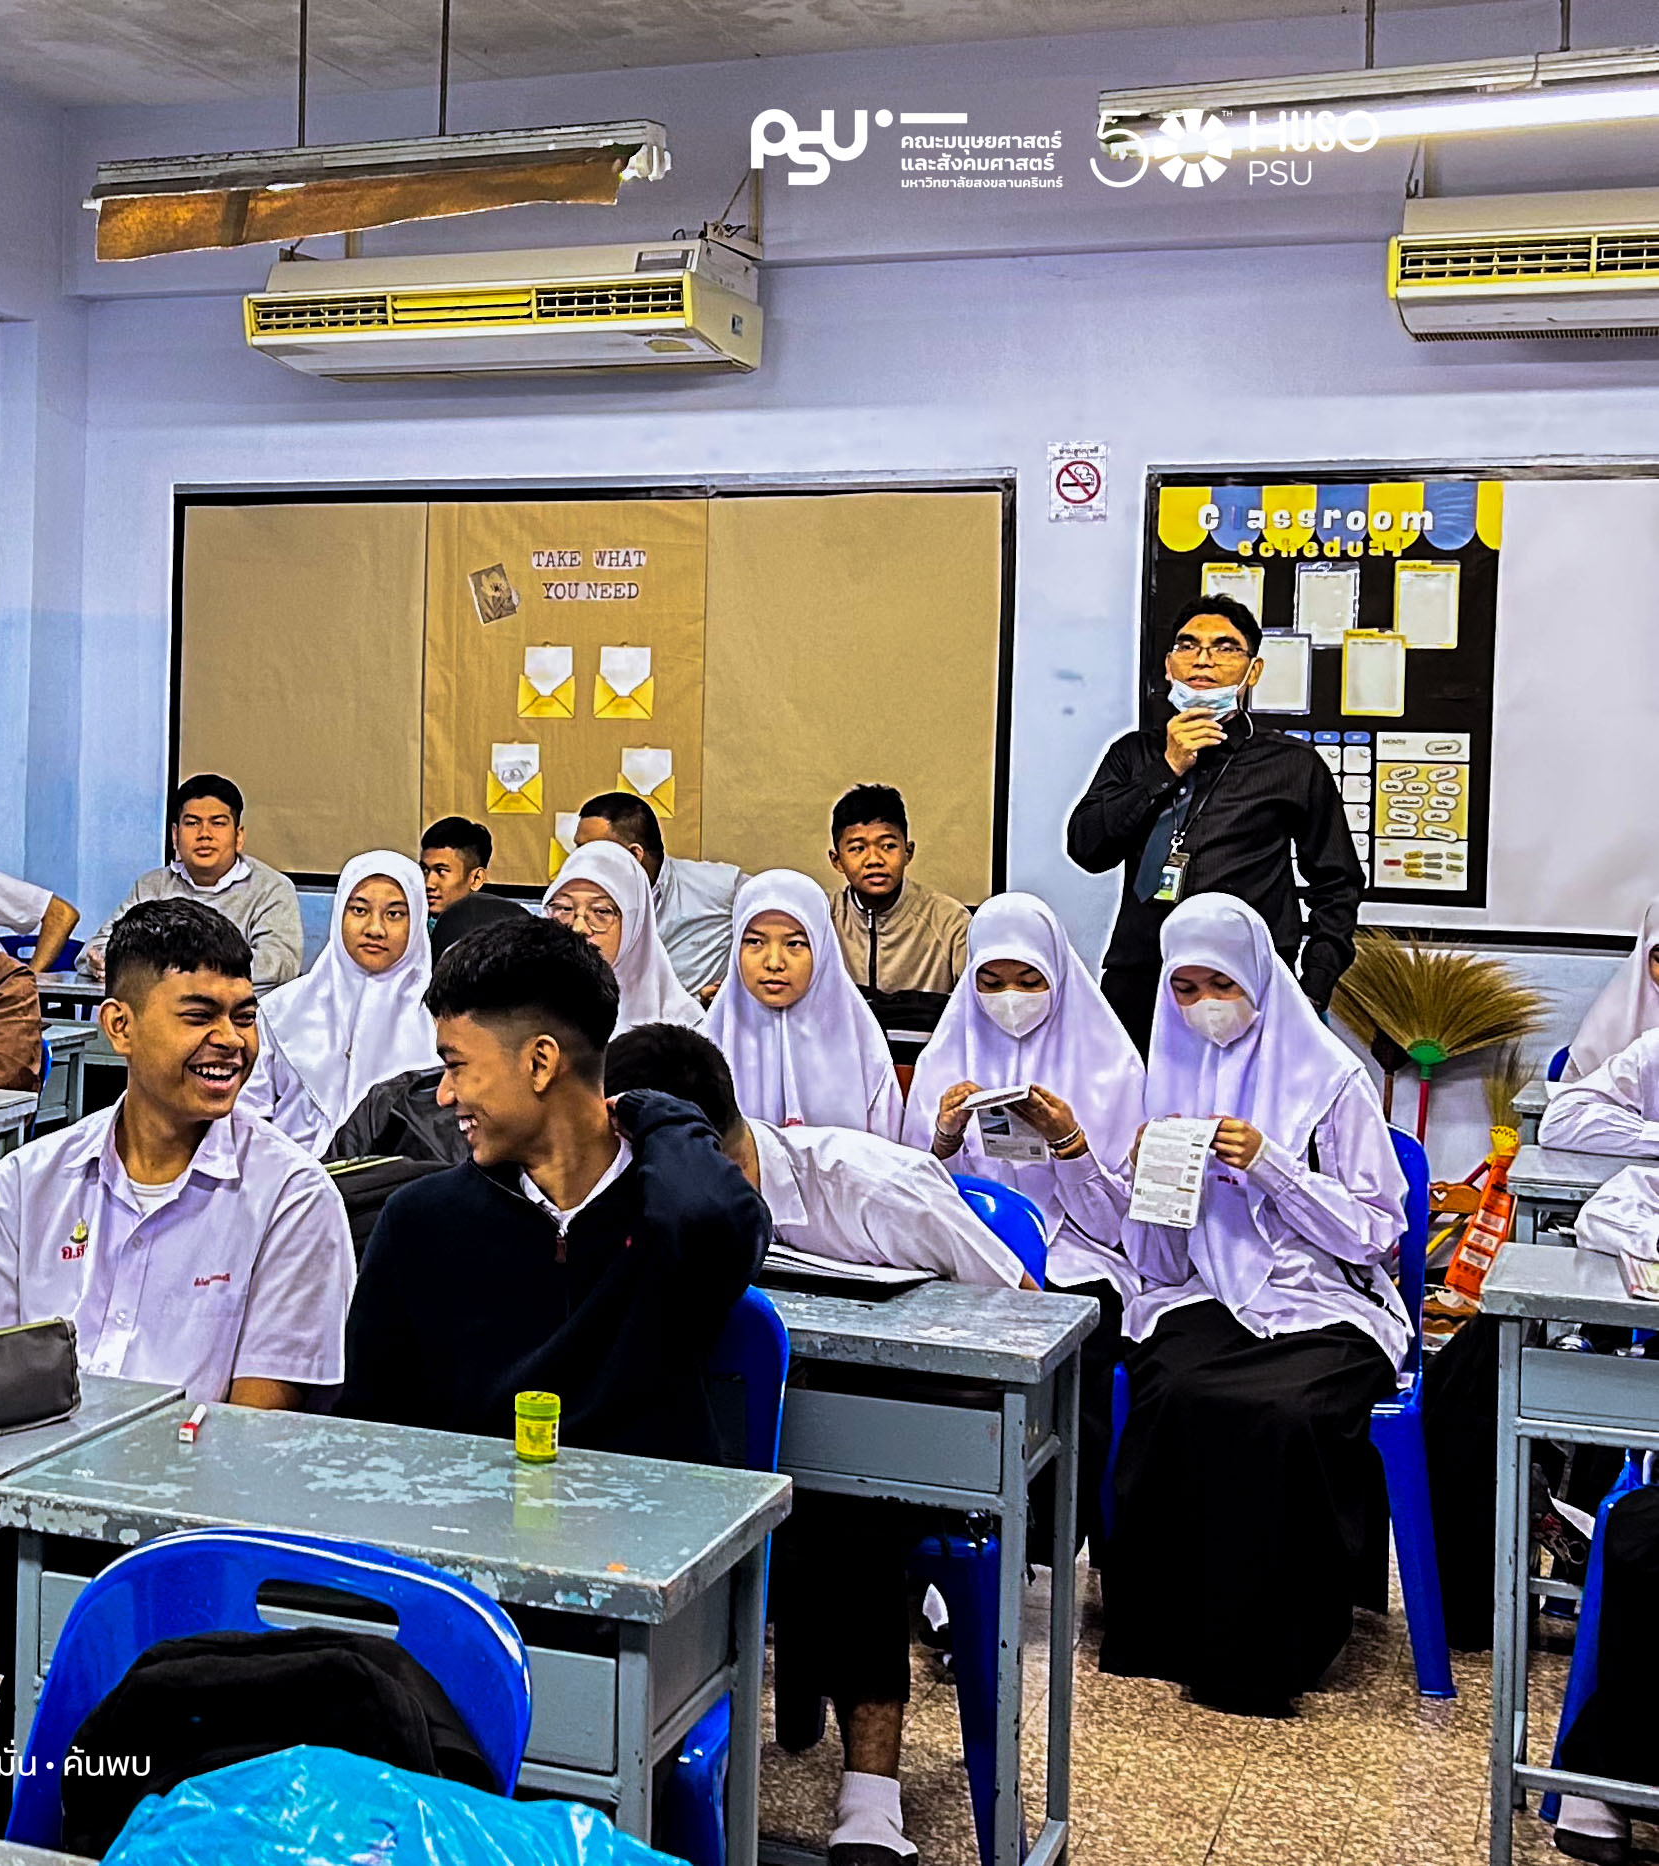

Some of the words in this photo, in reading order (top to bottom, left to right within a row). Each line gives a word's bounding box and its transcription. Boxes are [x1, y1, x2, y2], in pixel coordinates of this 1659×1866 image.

[532, 550, 581, 568] TAKE
[594, 549, 646, 567] WHAT
[541, 582, 579, 600] YOU
[585, 582, 640, 600] NEED
